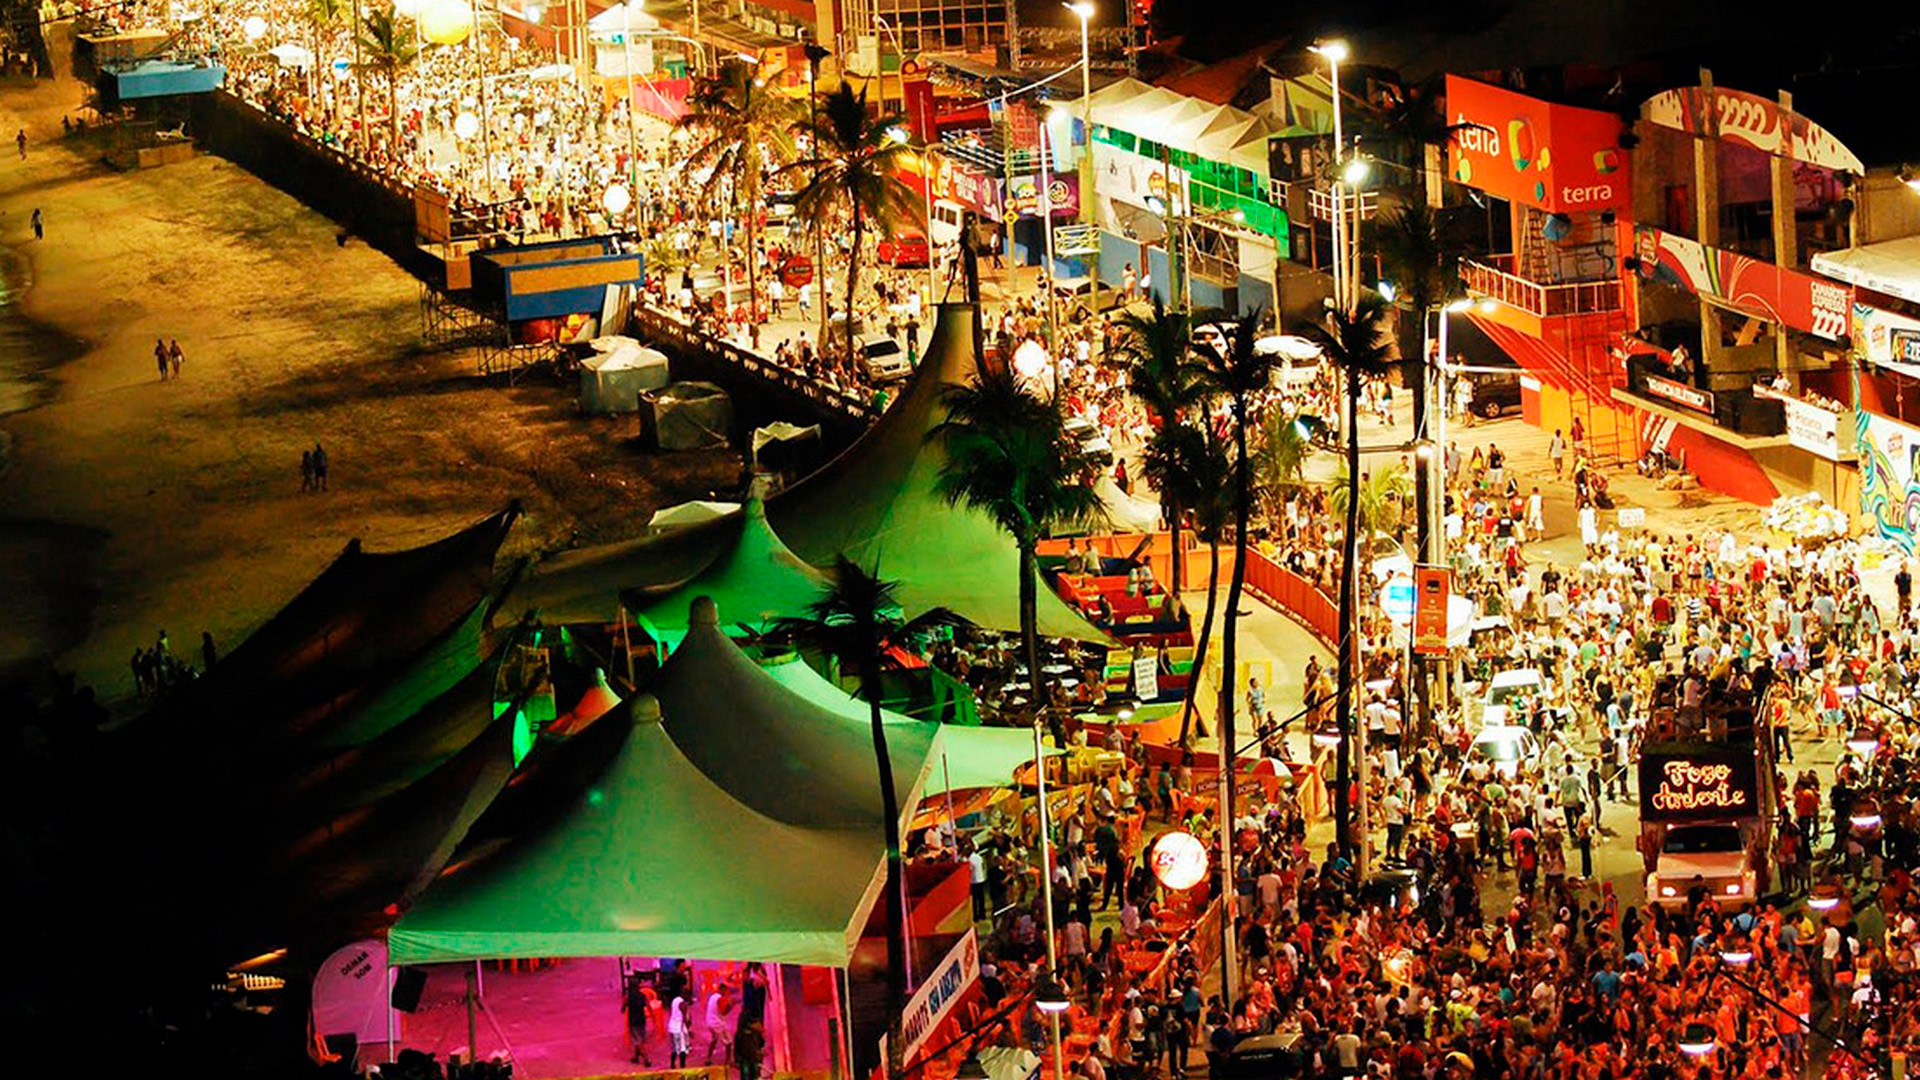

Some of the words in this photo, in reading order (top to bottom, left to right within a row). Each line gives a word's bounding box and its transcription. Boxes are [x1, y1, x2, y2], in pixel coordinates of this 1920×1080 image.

[1718, 95, 1768, 137] 2222
[1457, 113, 1500, 157] terra
[1563, 185, 1612, 204] terra
[1811, 306, 1847, 342] 2222
[1664, 761, 1732, 787] Fogo
